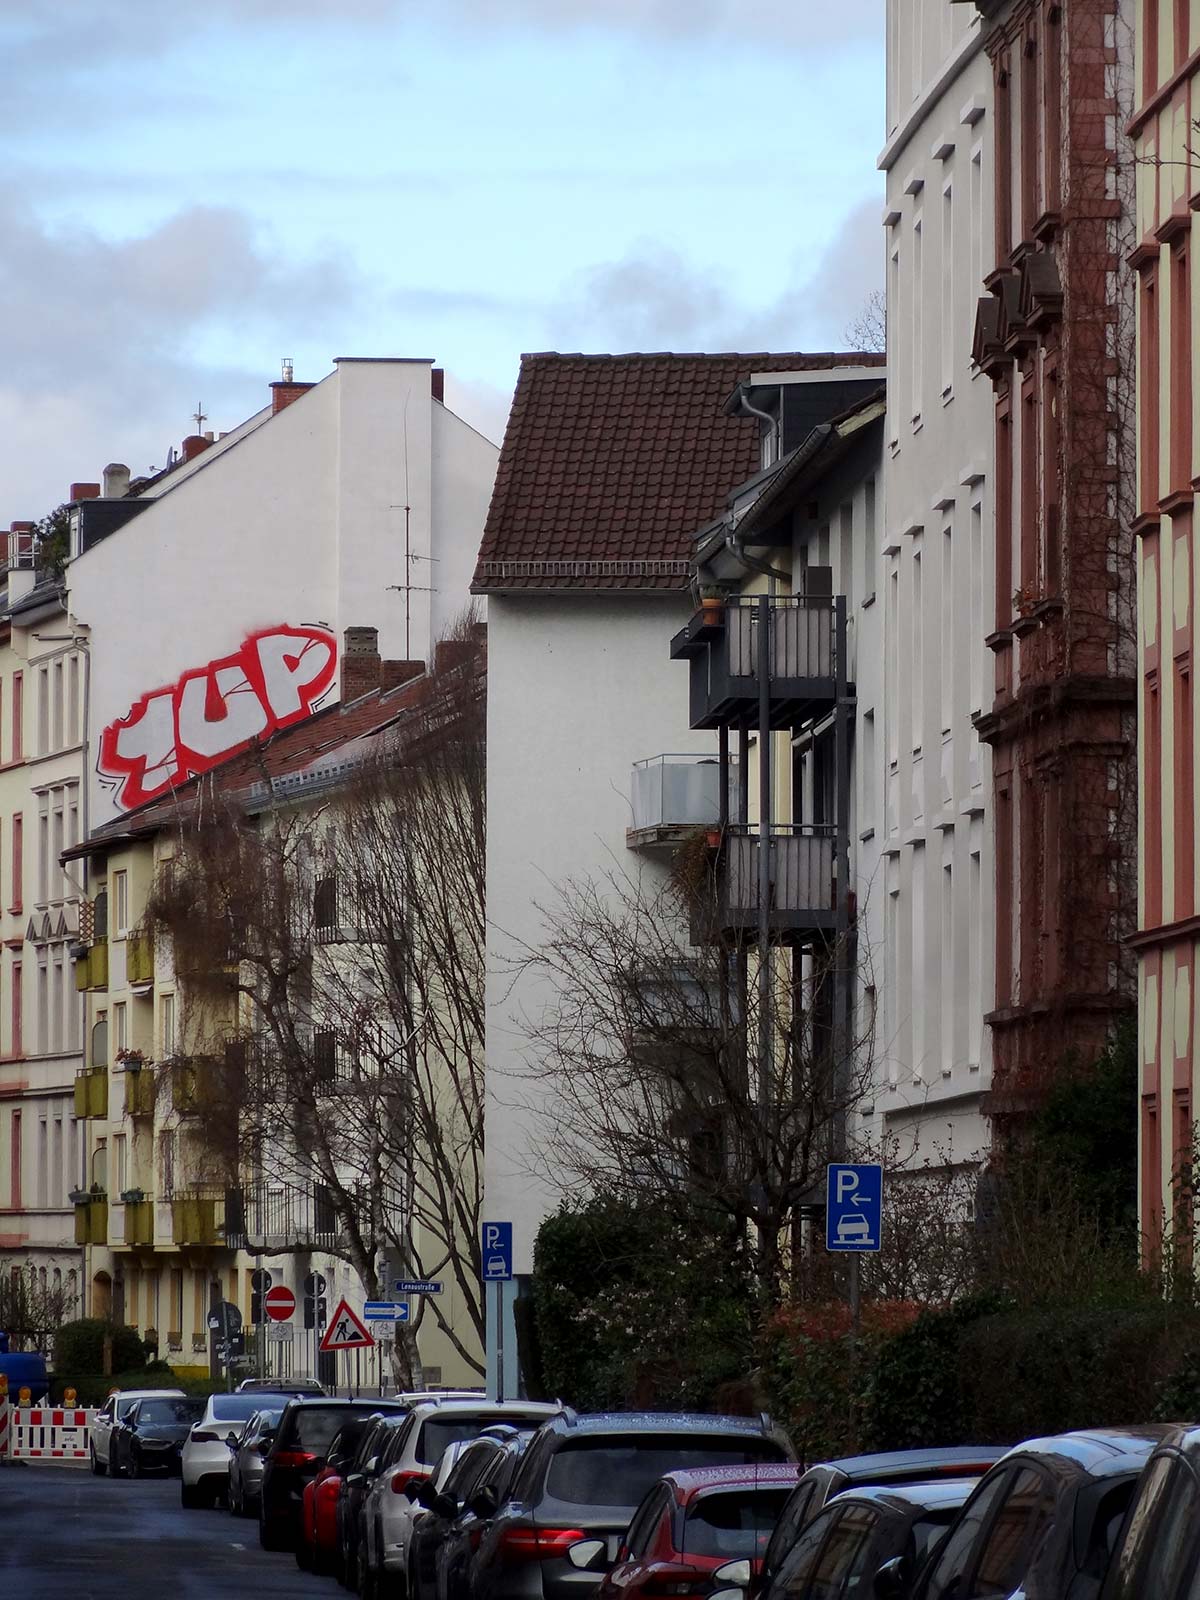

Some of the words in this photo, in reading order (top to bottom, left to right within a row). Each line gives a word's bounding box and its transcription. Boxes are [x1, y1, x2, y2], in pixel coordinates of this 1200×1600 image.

[103, 627, 336, 804] 1UP
[836, 1170, 859, 1203] P
[486, 1225, 500, 1249] P
